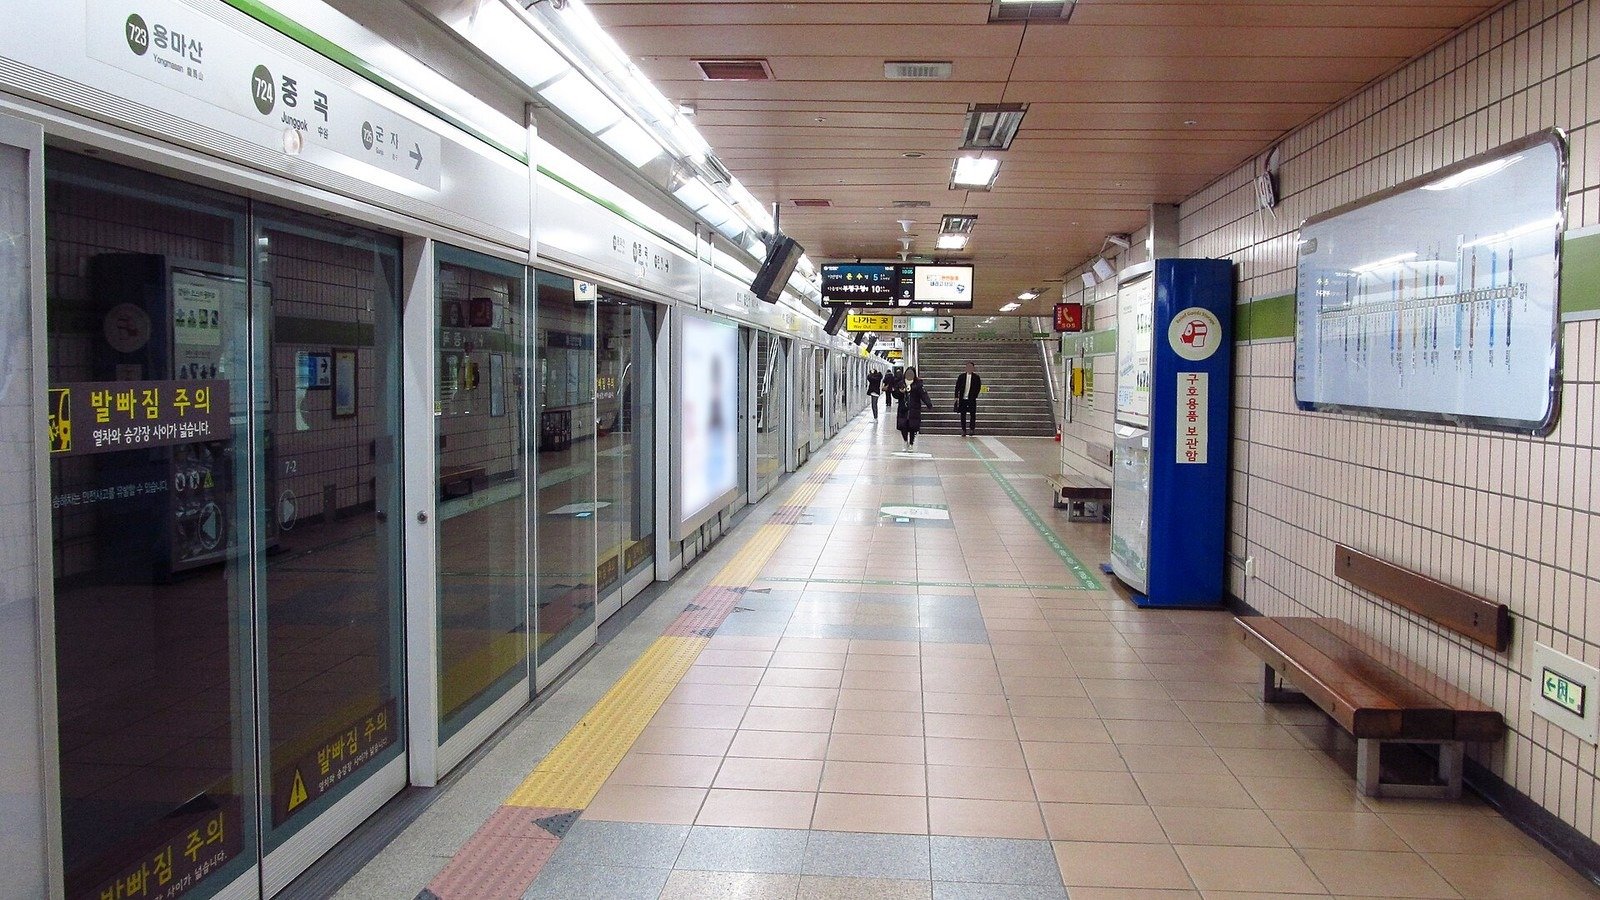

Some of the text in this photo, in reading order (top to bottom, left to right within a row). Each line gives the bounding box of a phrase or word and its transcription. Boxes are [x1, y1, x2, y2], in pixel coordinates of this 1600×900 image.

[128, 22, 203, 64] 723 용마산
[254, 75, 274, 104] 724
[281, 111, 308, 131] Junggok
[872, 285, 881, 293] 10
[873, 273, 879, 281] 5
[853, 316, 877, 324] 나가는
[881, 316, 889, 325] 곳
[91, 386, 210, 423] 발빠짐 주의
[1186, 373, 1199, 462] 구호용품 보관함
[92, 420, 211, 447] 열차와 승강장 사이가 넓습니다.
[316, 706, 387, 776] 발빠짐 주의
[184, 810, 224, 862] 주의
[167, 850, 228, 898] 사이가 넓습니다.
